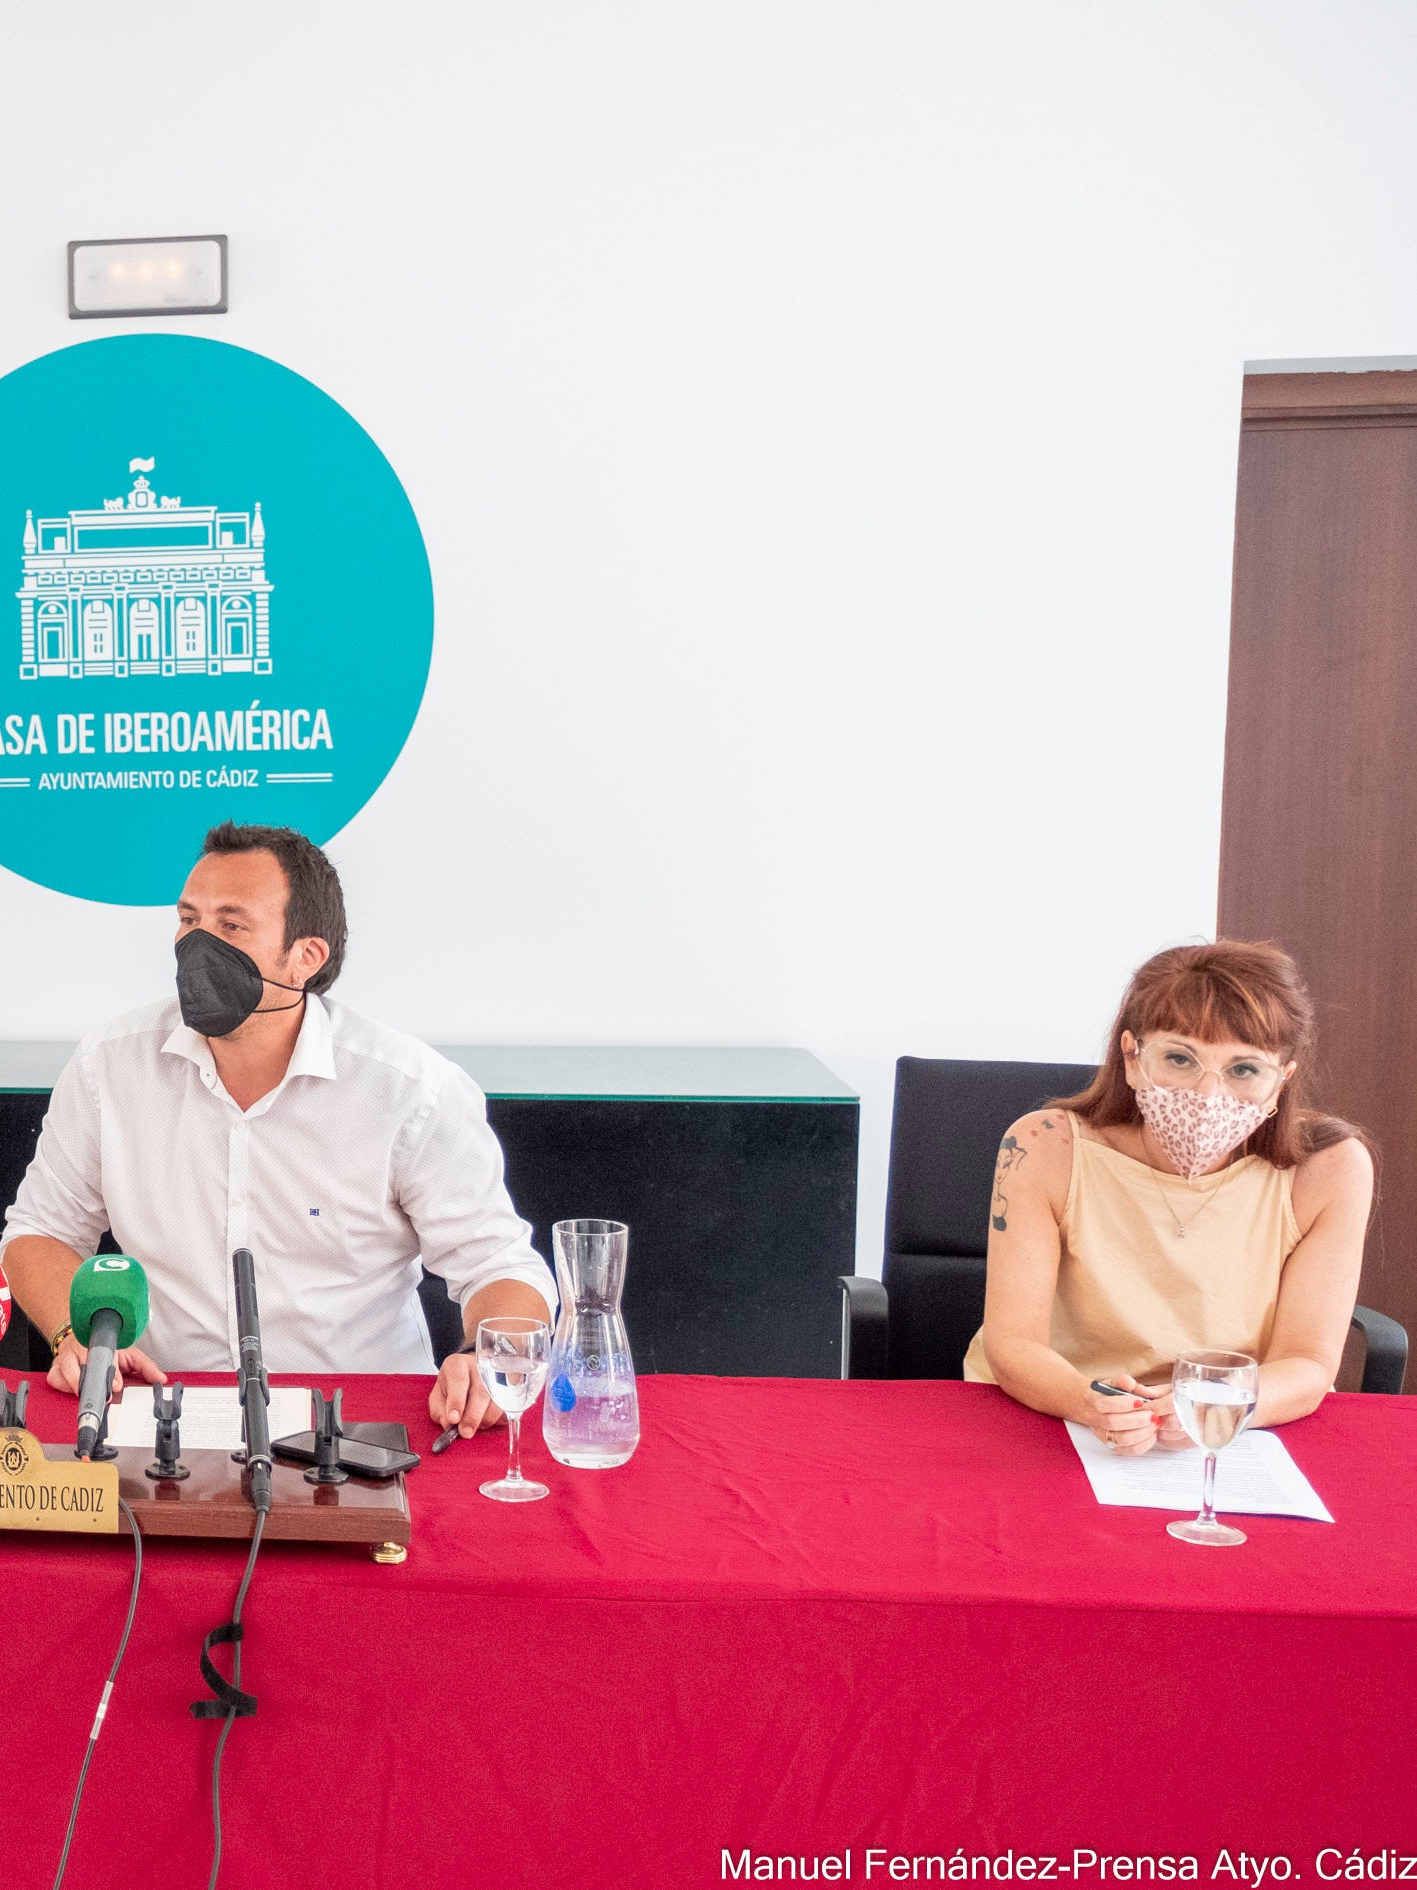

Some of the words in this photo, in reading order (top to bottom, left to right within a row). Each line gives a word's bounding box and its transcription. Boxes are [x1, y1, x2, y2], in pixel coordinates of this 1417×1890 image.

[57, 713, 96, 755] DE
[104, 699, 334, 755] IBEROAMÉRICA
[38, 770, 175, 790] AYUNTAMIENTO
[179, 769, 202, 788] DE
[205, 765, 259, 788] CÁDIZ
[39, 1485, 57, 1511] DE
[60, 1486, 104, 1513] CADIZ
